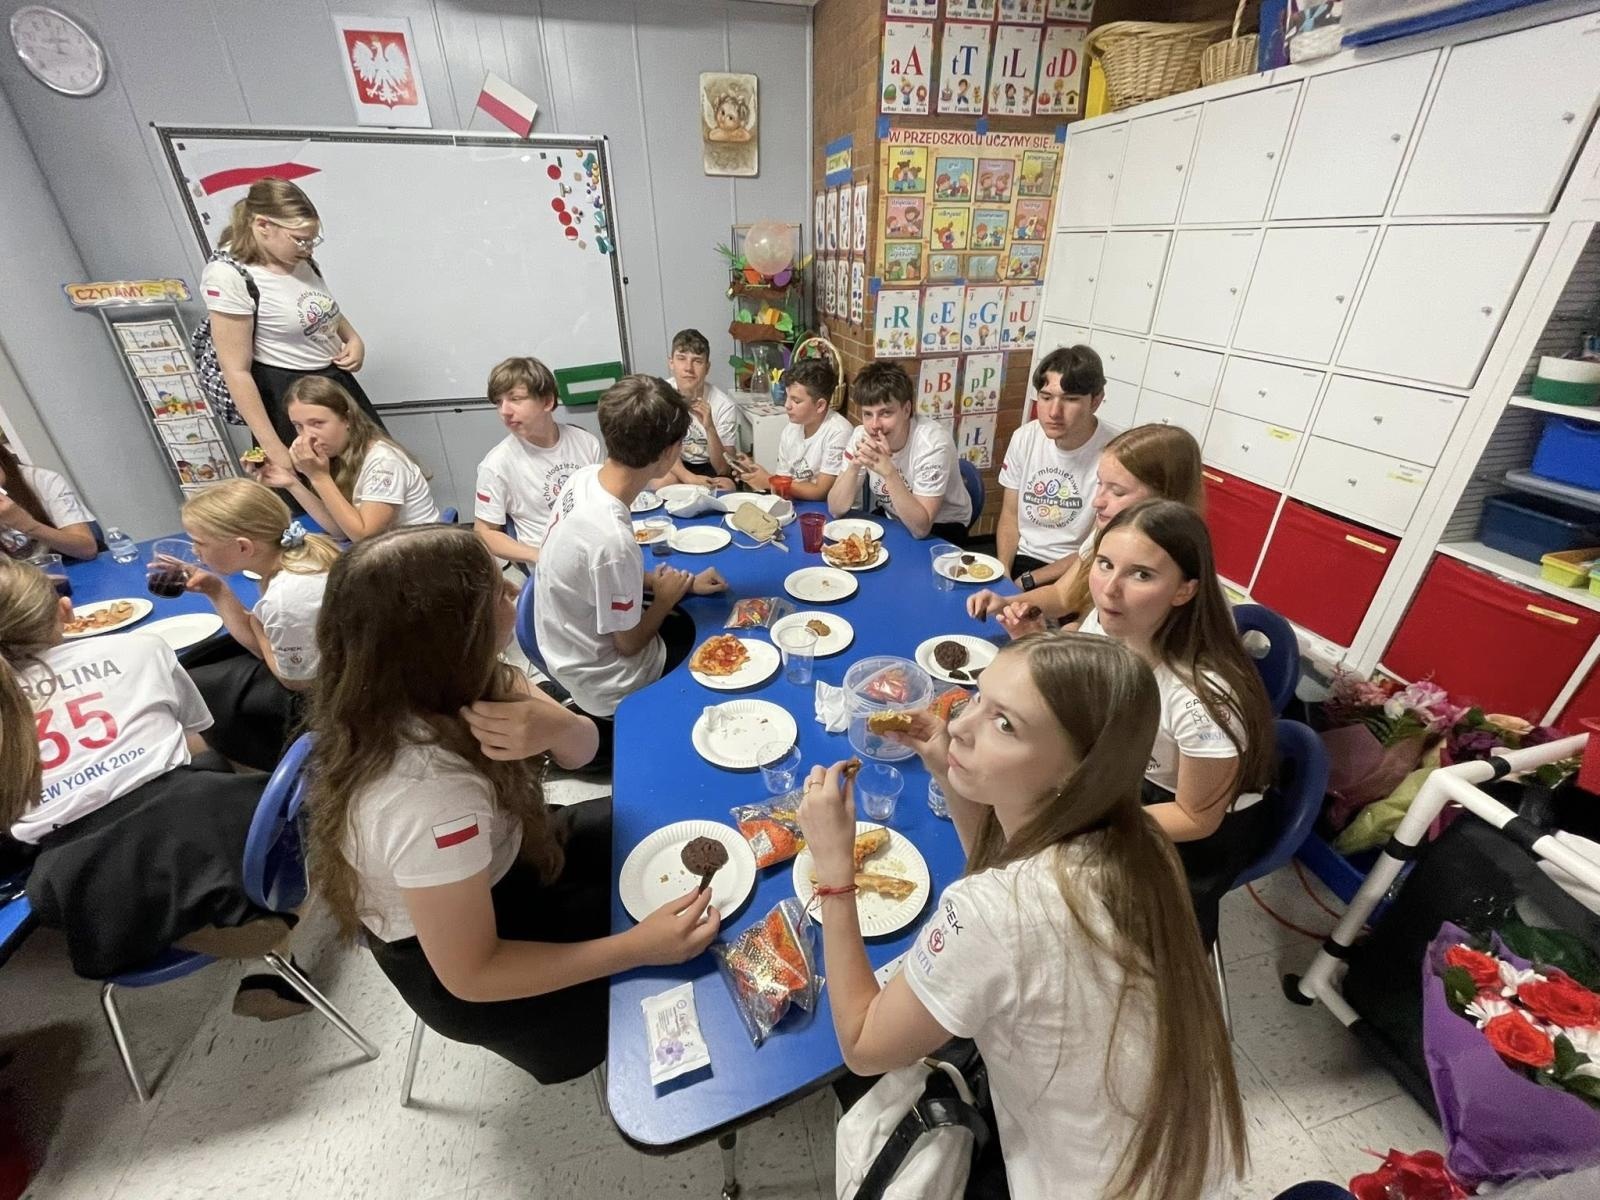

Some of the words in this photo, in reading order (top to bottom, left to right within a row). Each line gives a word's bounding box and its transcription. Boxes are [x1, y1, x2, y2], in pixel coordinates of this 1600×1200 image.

[888, 131, 900, 144] W
[903, 131, 983, 146] PRZEDSZKOLU
[985, 134, 1031, 147] UCZYMY
[39, 783, 62, 804] EW
[63, 761, 110, 791] YORK
